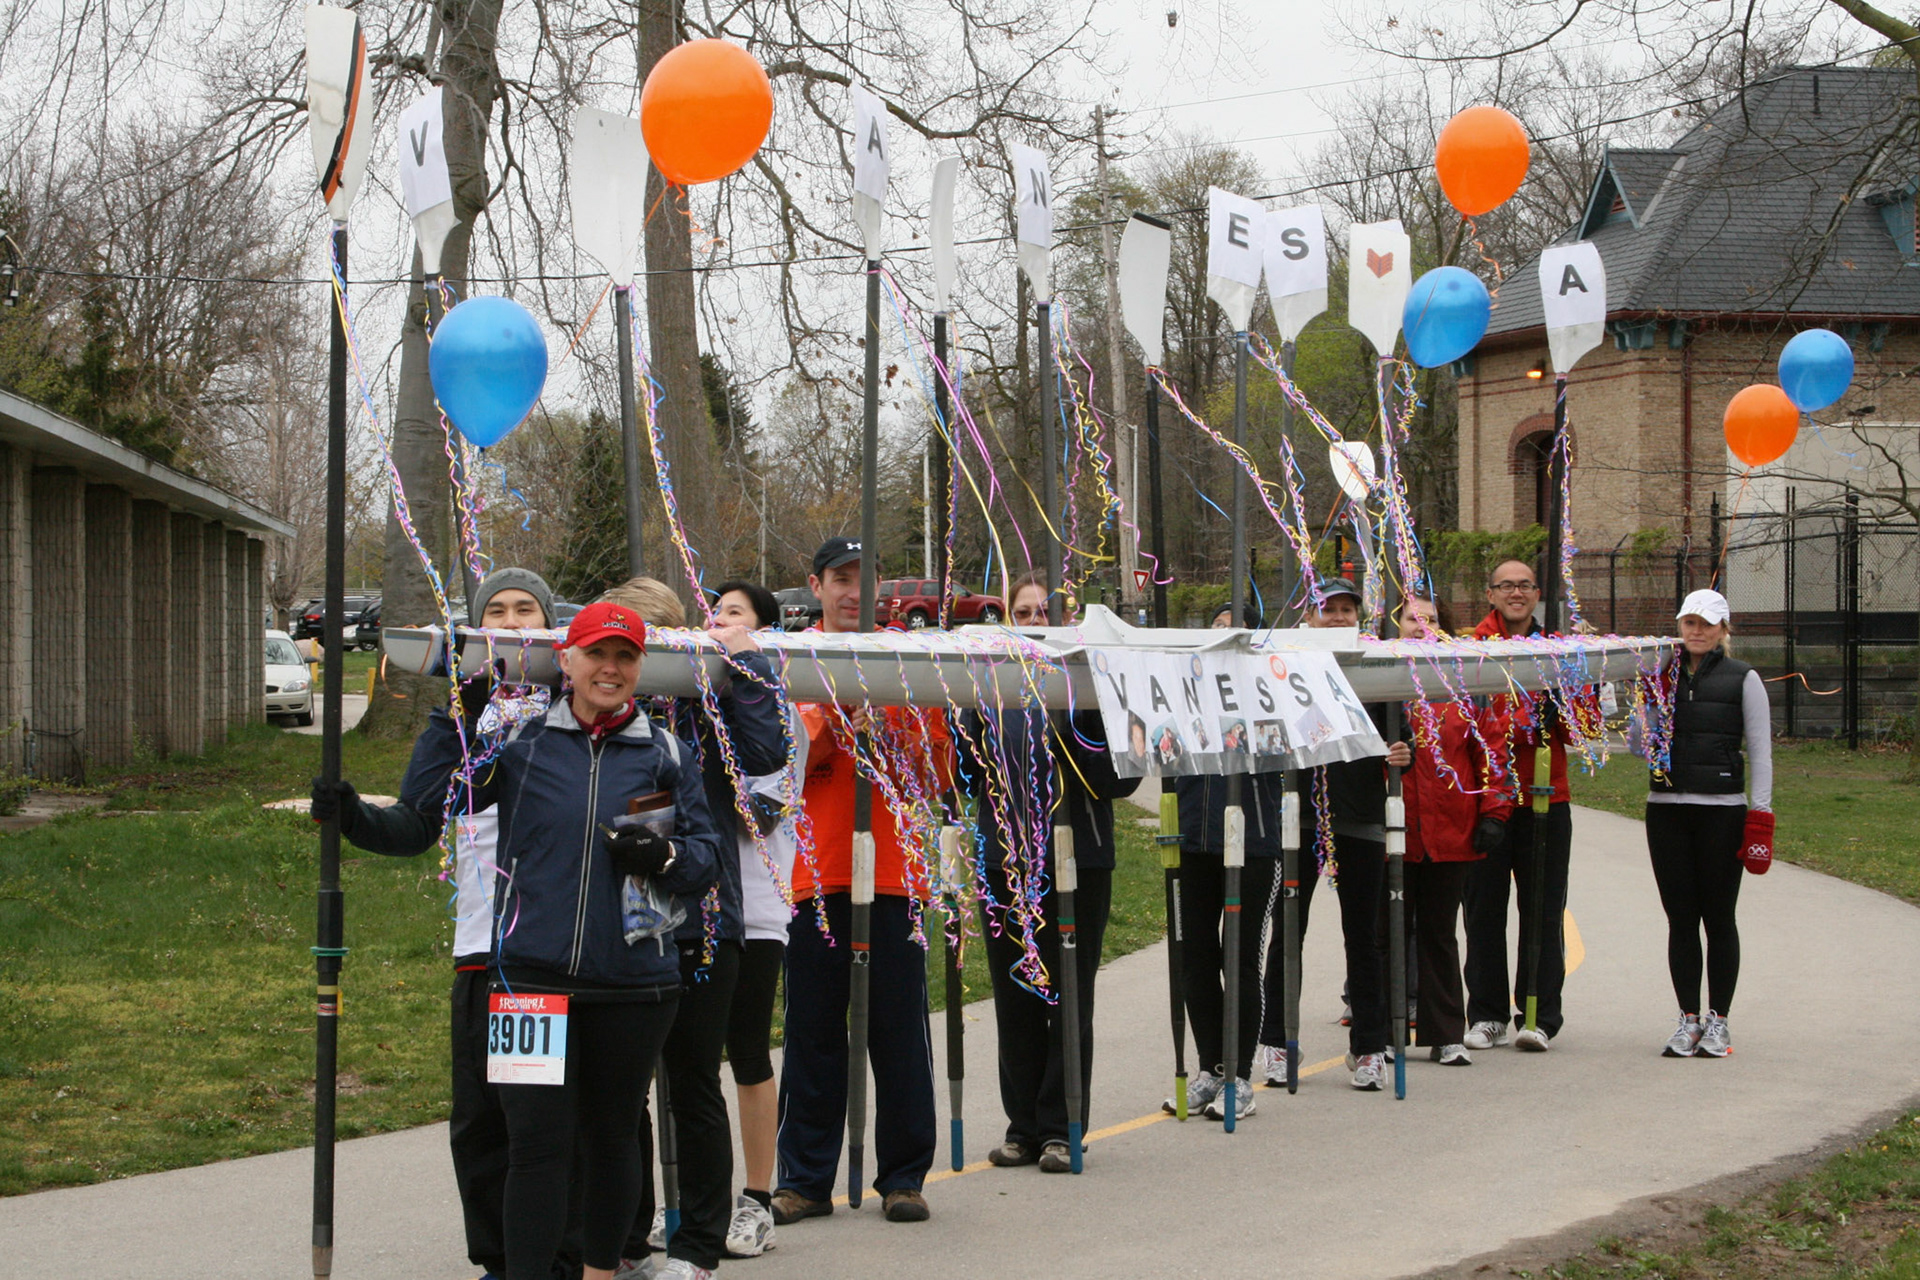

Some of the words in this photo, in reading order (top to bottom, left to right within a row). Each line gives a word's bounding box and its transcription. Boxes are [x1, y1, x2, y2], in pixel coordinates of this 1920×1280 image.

[410, 120, 429, 168] V
[868, 115, 883, 161] A
[1030, 167, 1047, 209] N
[1228, 212, 1250, 250] E
[1280, 227, 1310, 261] S
[1559, 264, 1589, 296] A
[1107, 669, 1351, 714] VANESSA
[489, 1013, 551, 1055] 3901
